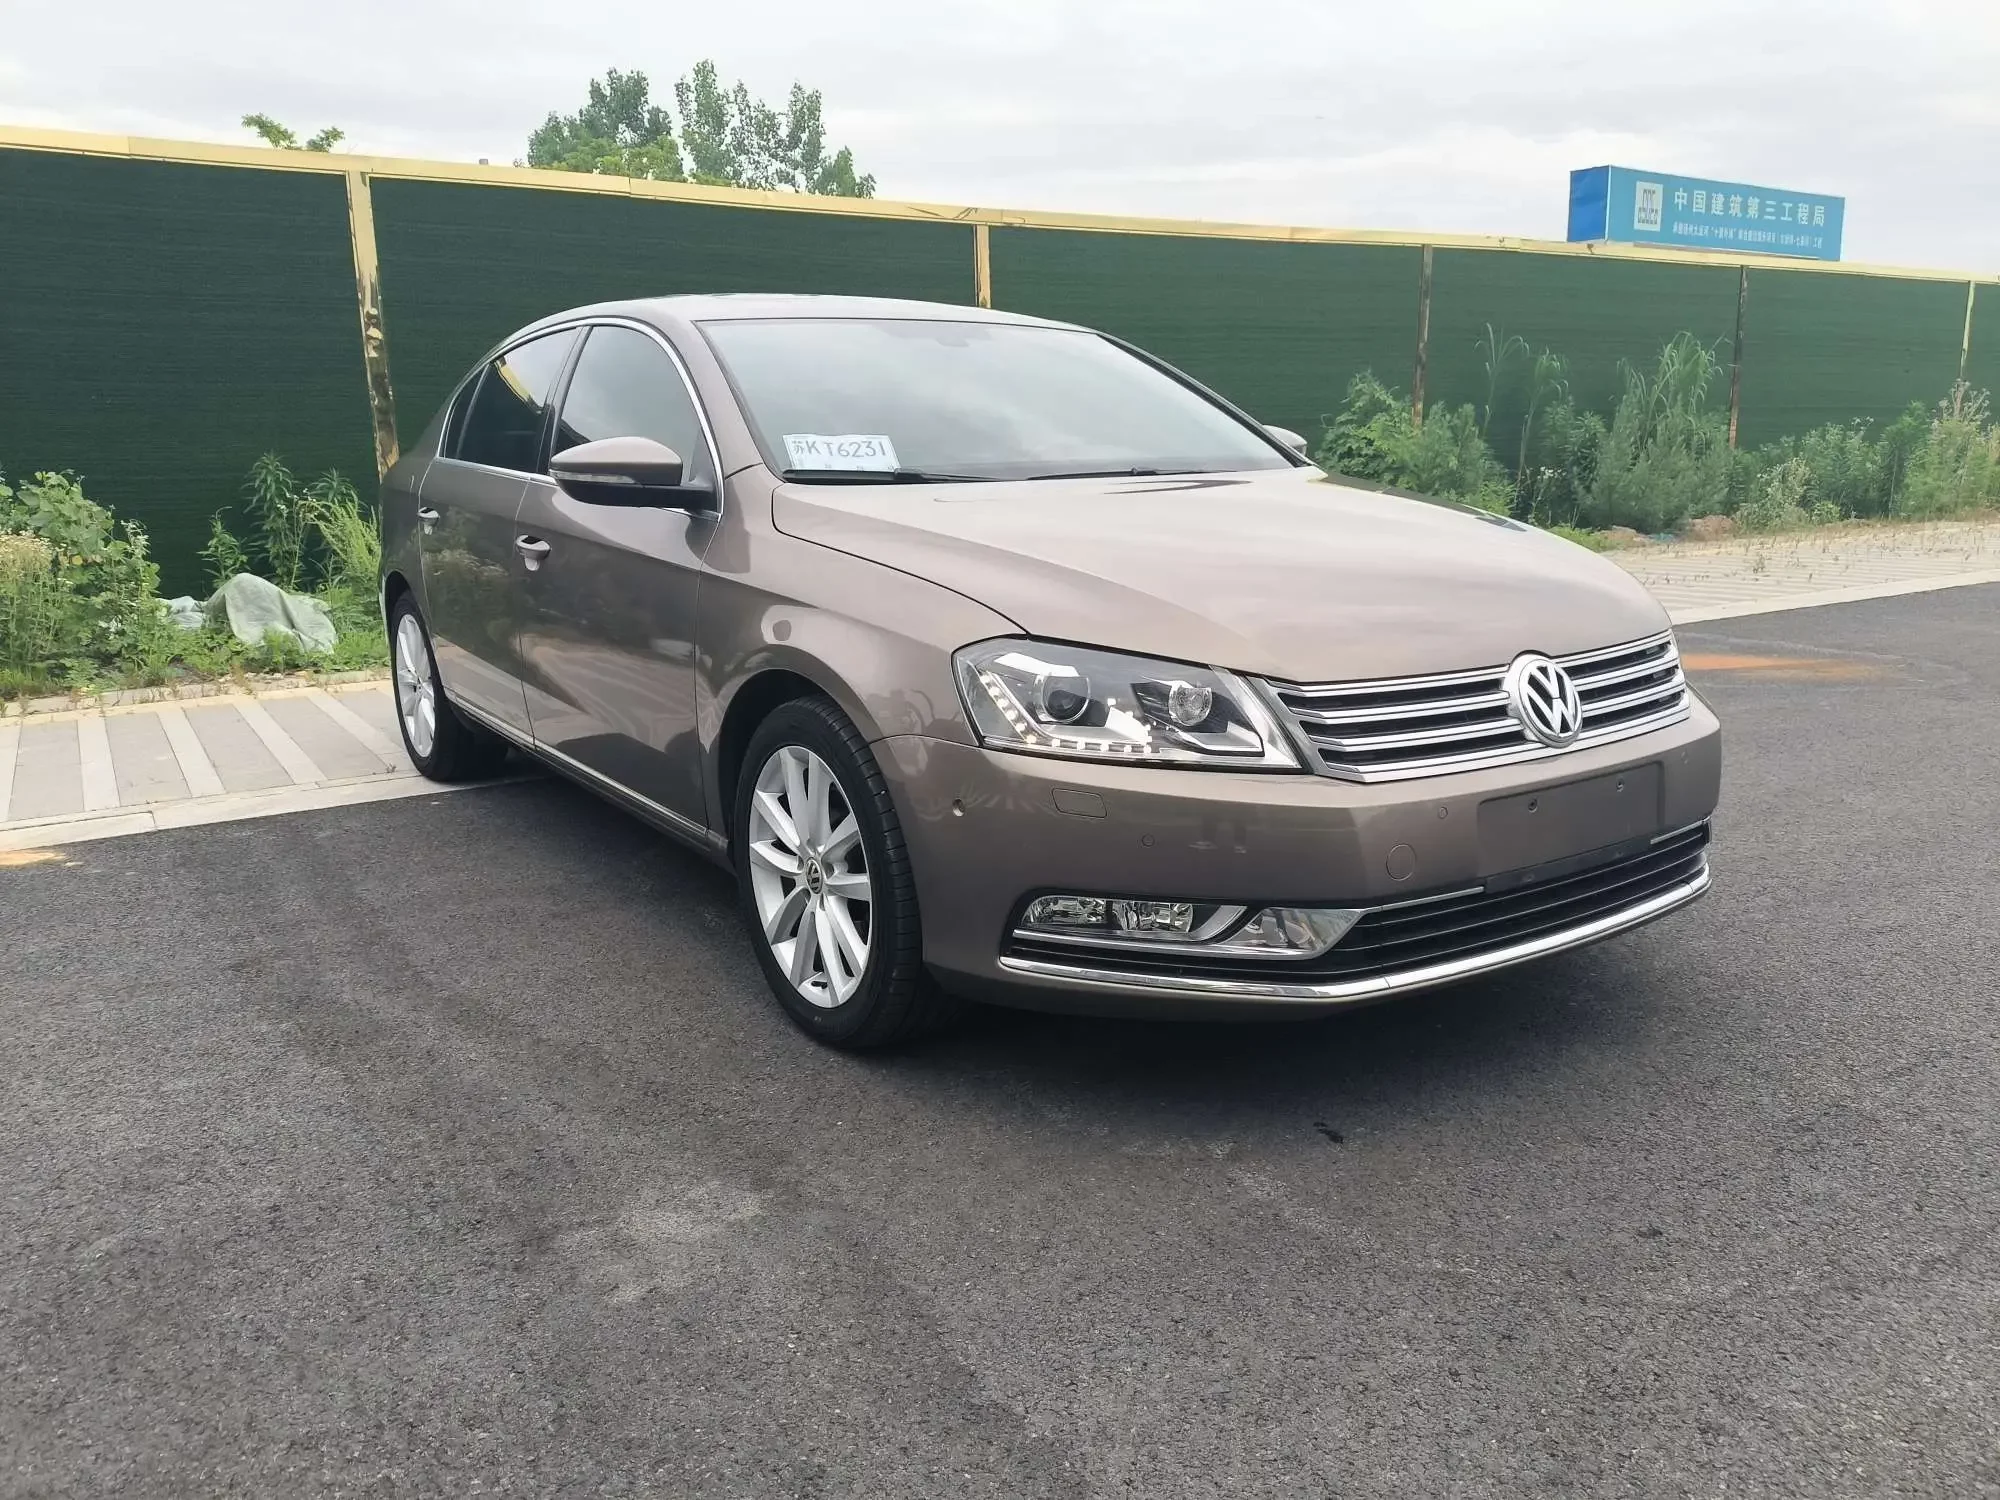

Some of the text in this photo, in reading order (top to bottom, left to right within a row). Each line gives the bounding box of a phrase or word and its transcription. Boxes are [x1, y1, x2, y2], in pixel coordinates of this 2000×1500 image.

[1674, 188, 1825, 227] 中国建筑第三工程局
